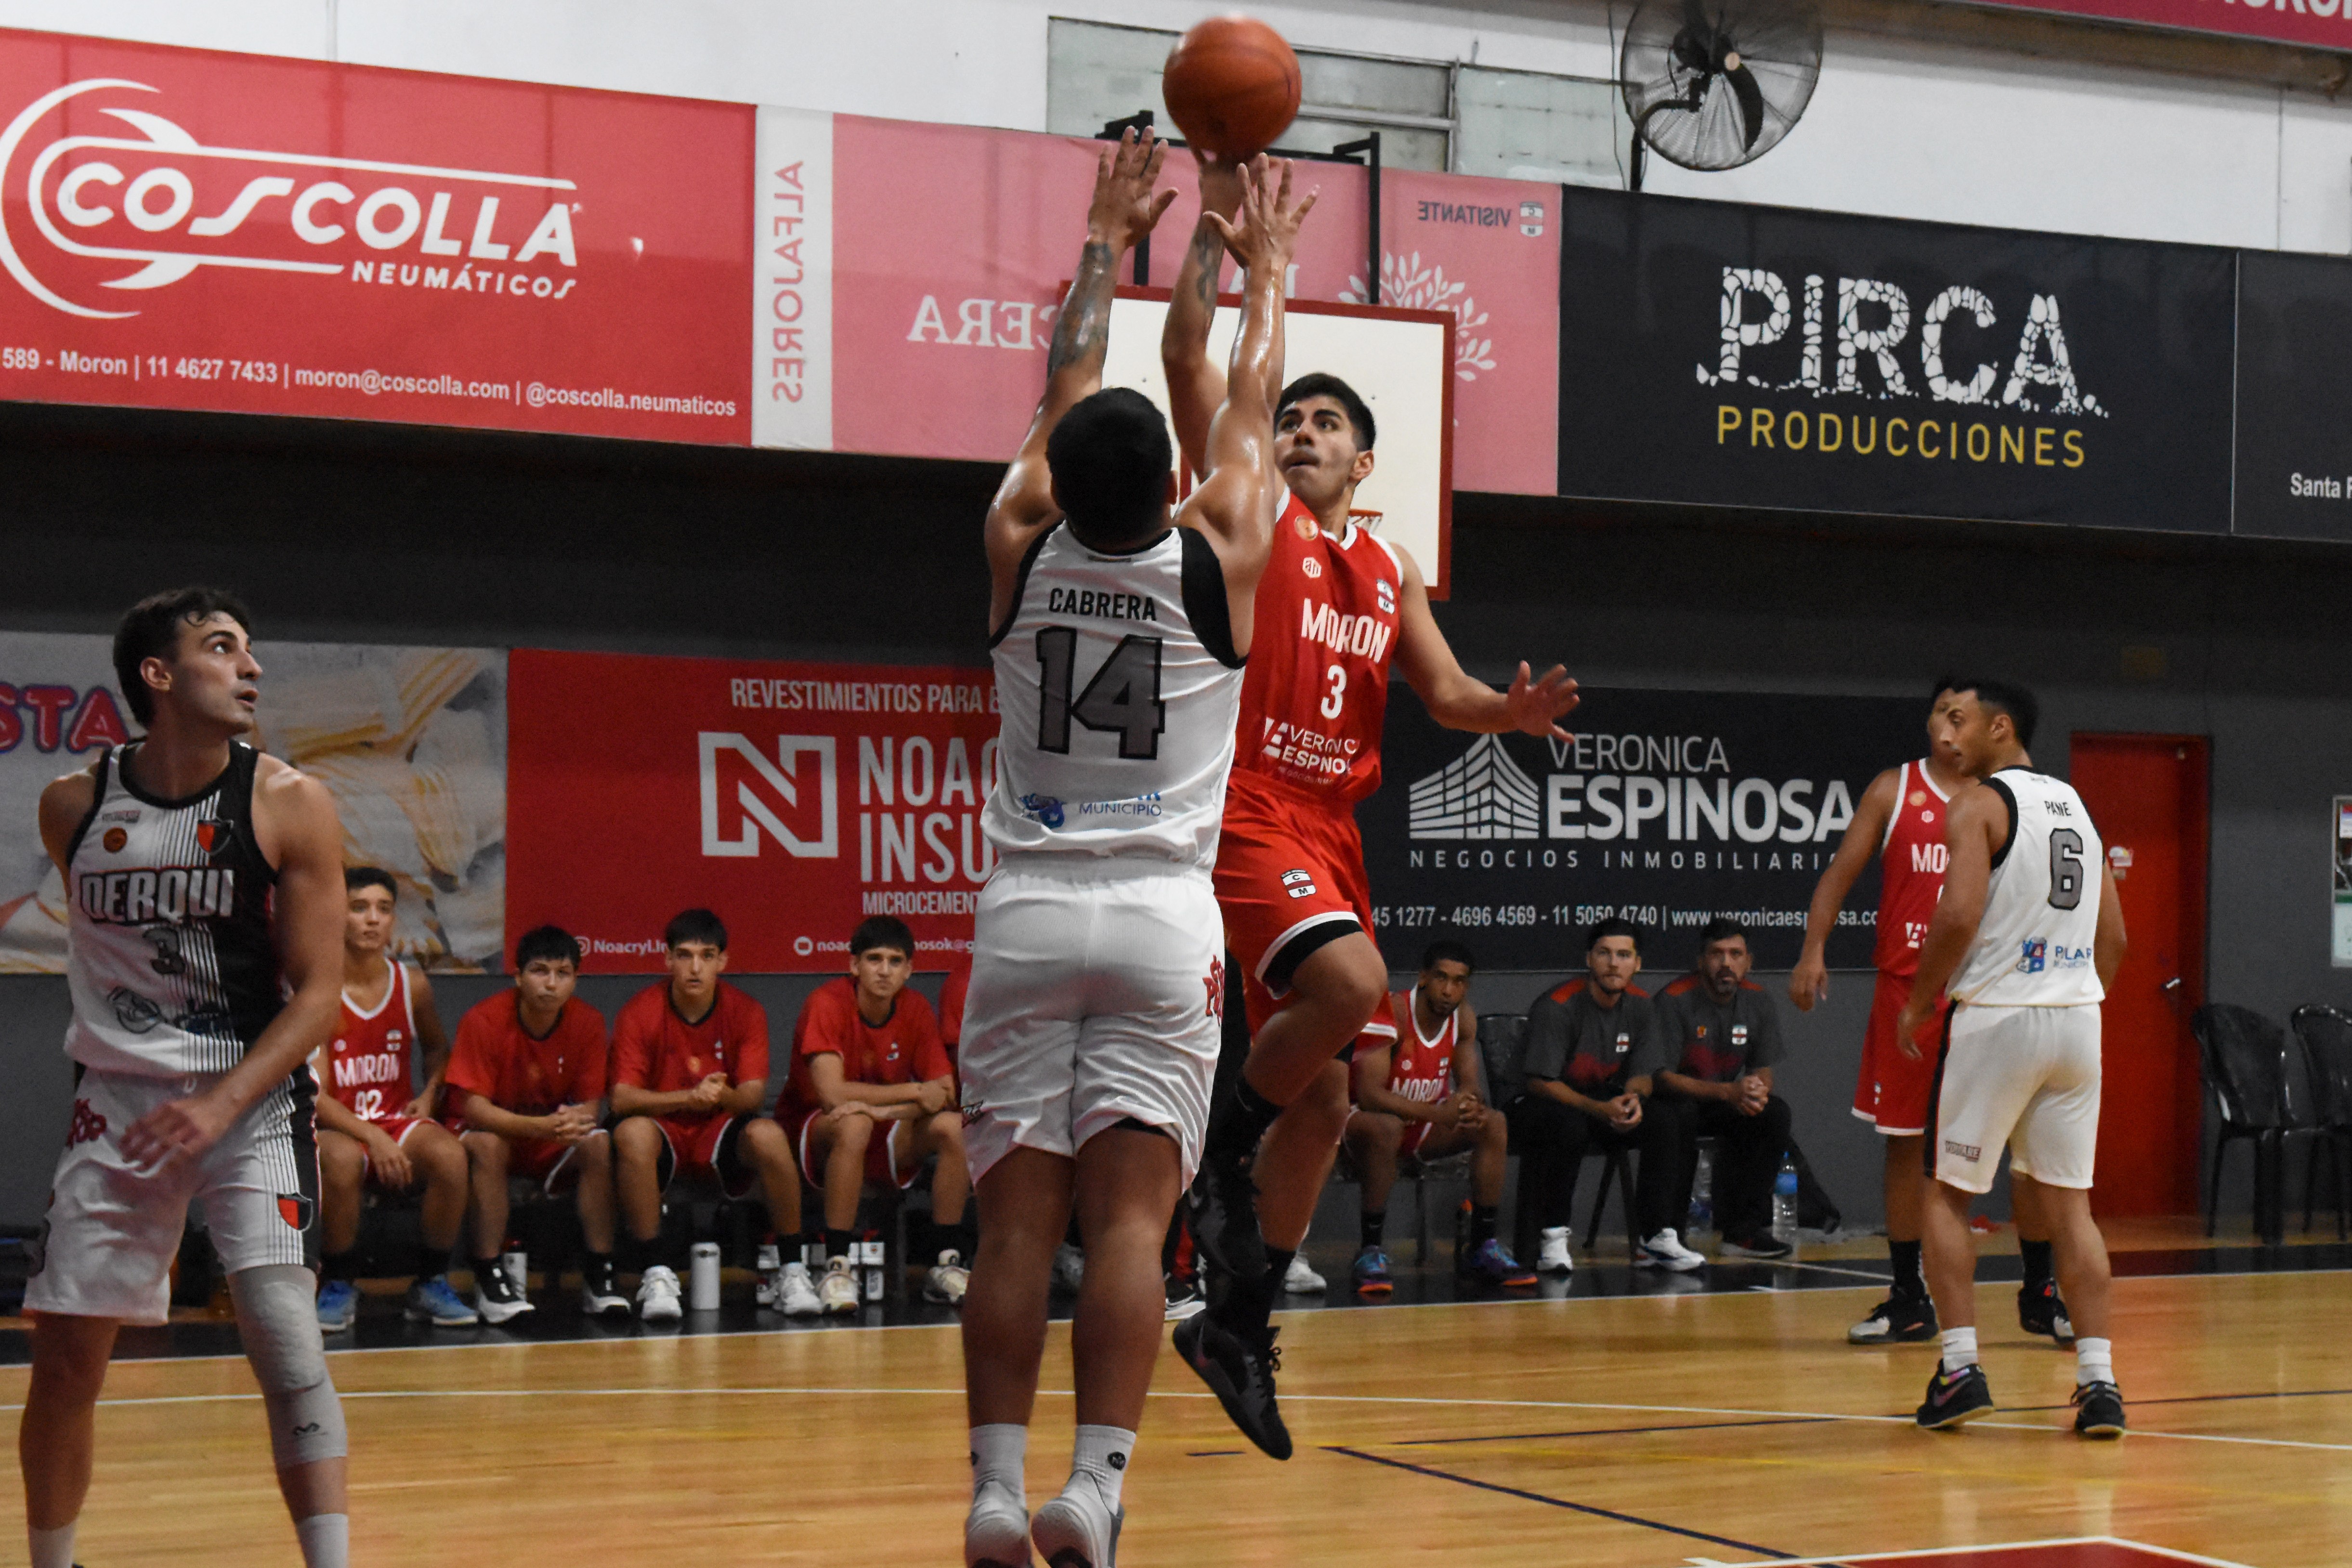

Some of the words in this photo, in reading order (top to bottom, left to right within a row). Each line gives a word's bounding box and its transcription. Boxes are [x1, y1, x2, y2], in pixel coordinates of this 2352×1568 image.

[56, 162, 577, 267] COSCOLLA
[352, 261, 576, 300] NEUMÁTICOS
[1714, 266, 2090, 416] PIRCA
[2, 347, 39, 369] 589
[60, 350, 127, 375] Moron
[147, 357, 167, 377] 11
[175, 357, 223, 379] 4627
[230, 360, 277, 382] 7433
[295, 368, 510, 400] moron@coscolla.com
[526, 381, 736, 417] @coscolla.neumaticos
[1717, 405, 2085, 468] PRODUCCIONES
[2290, 472, 2341, 498] Santa
[1049, 588, 1157, 621] CABRERA
[1301, 598, 1391, 664] MORON
[731, 678, 922, 713] REVESTIMIENTOS
[928, 684, 983, 714] PARA
[1036, 627, 1165, 760] 14
[1321, 665, 1347, 719] 3
[1548, 733, 1730, 773] VERONICA
[1079, 803, 1162, 816] MUNICIPIO
[1548, 774, 1854, 844] ESPINOSA
[1410, 849, 1579, 868] NEGOCIOS
[1912, 844, 1949, 873] MO
[2047, 828, 2083, 911] 6
[1396, 906, 1436, 926] 1277
[1451, 906, 1491, 927] 4696
[1496, 906, 1535, 926] 4569
[1553, 905, 1569, 925] 11
[1619, 906, 1657, 925] 4740
[334, 1053, 400, 1088] MORON
[354, 1089, 385, 1121] 92
